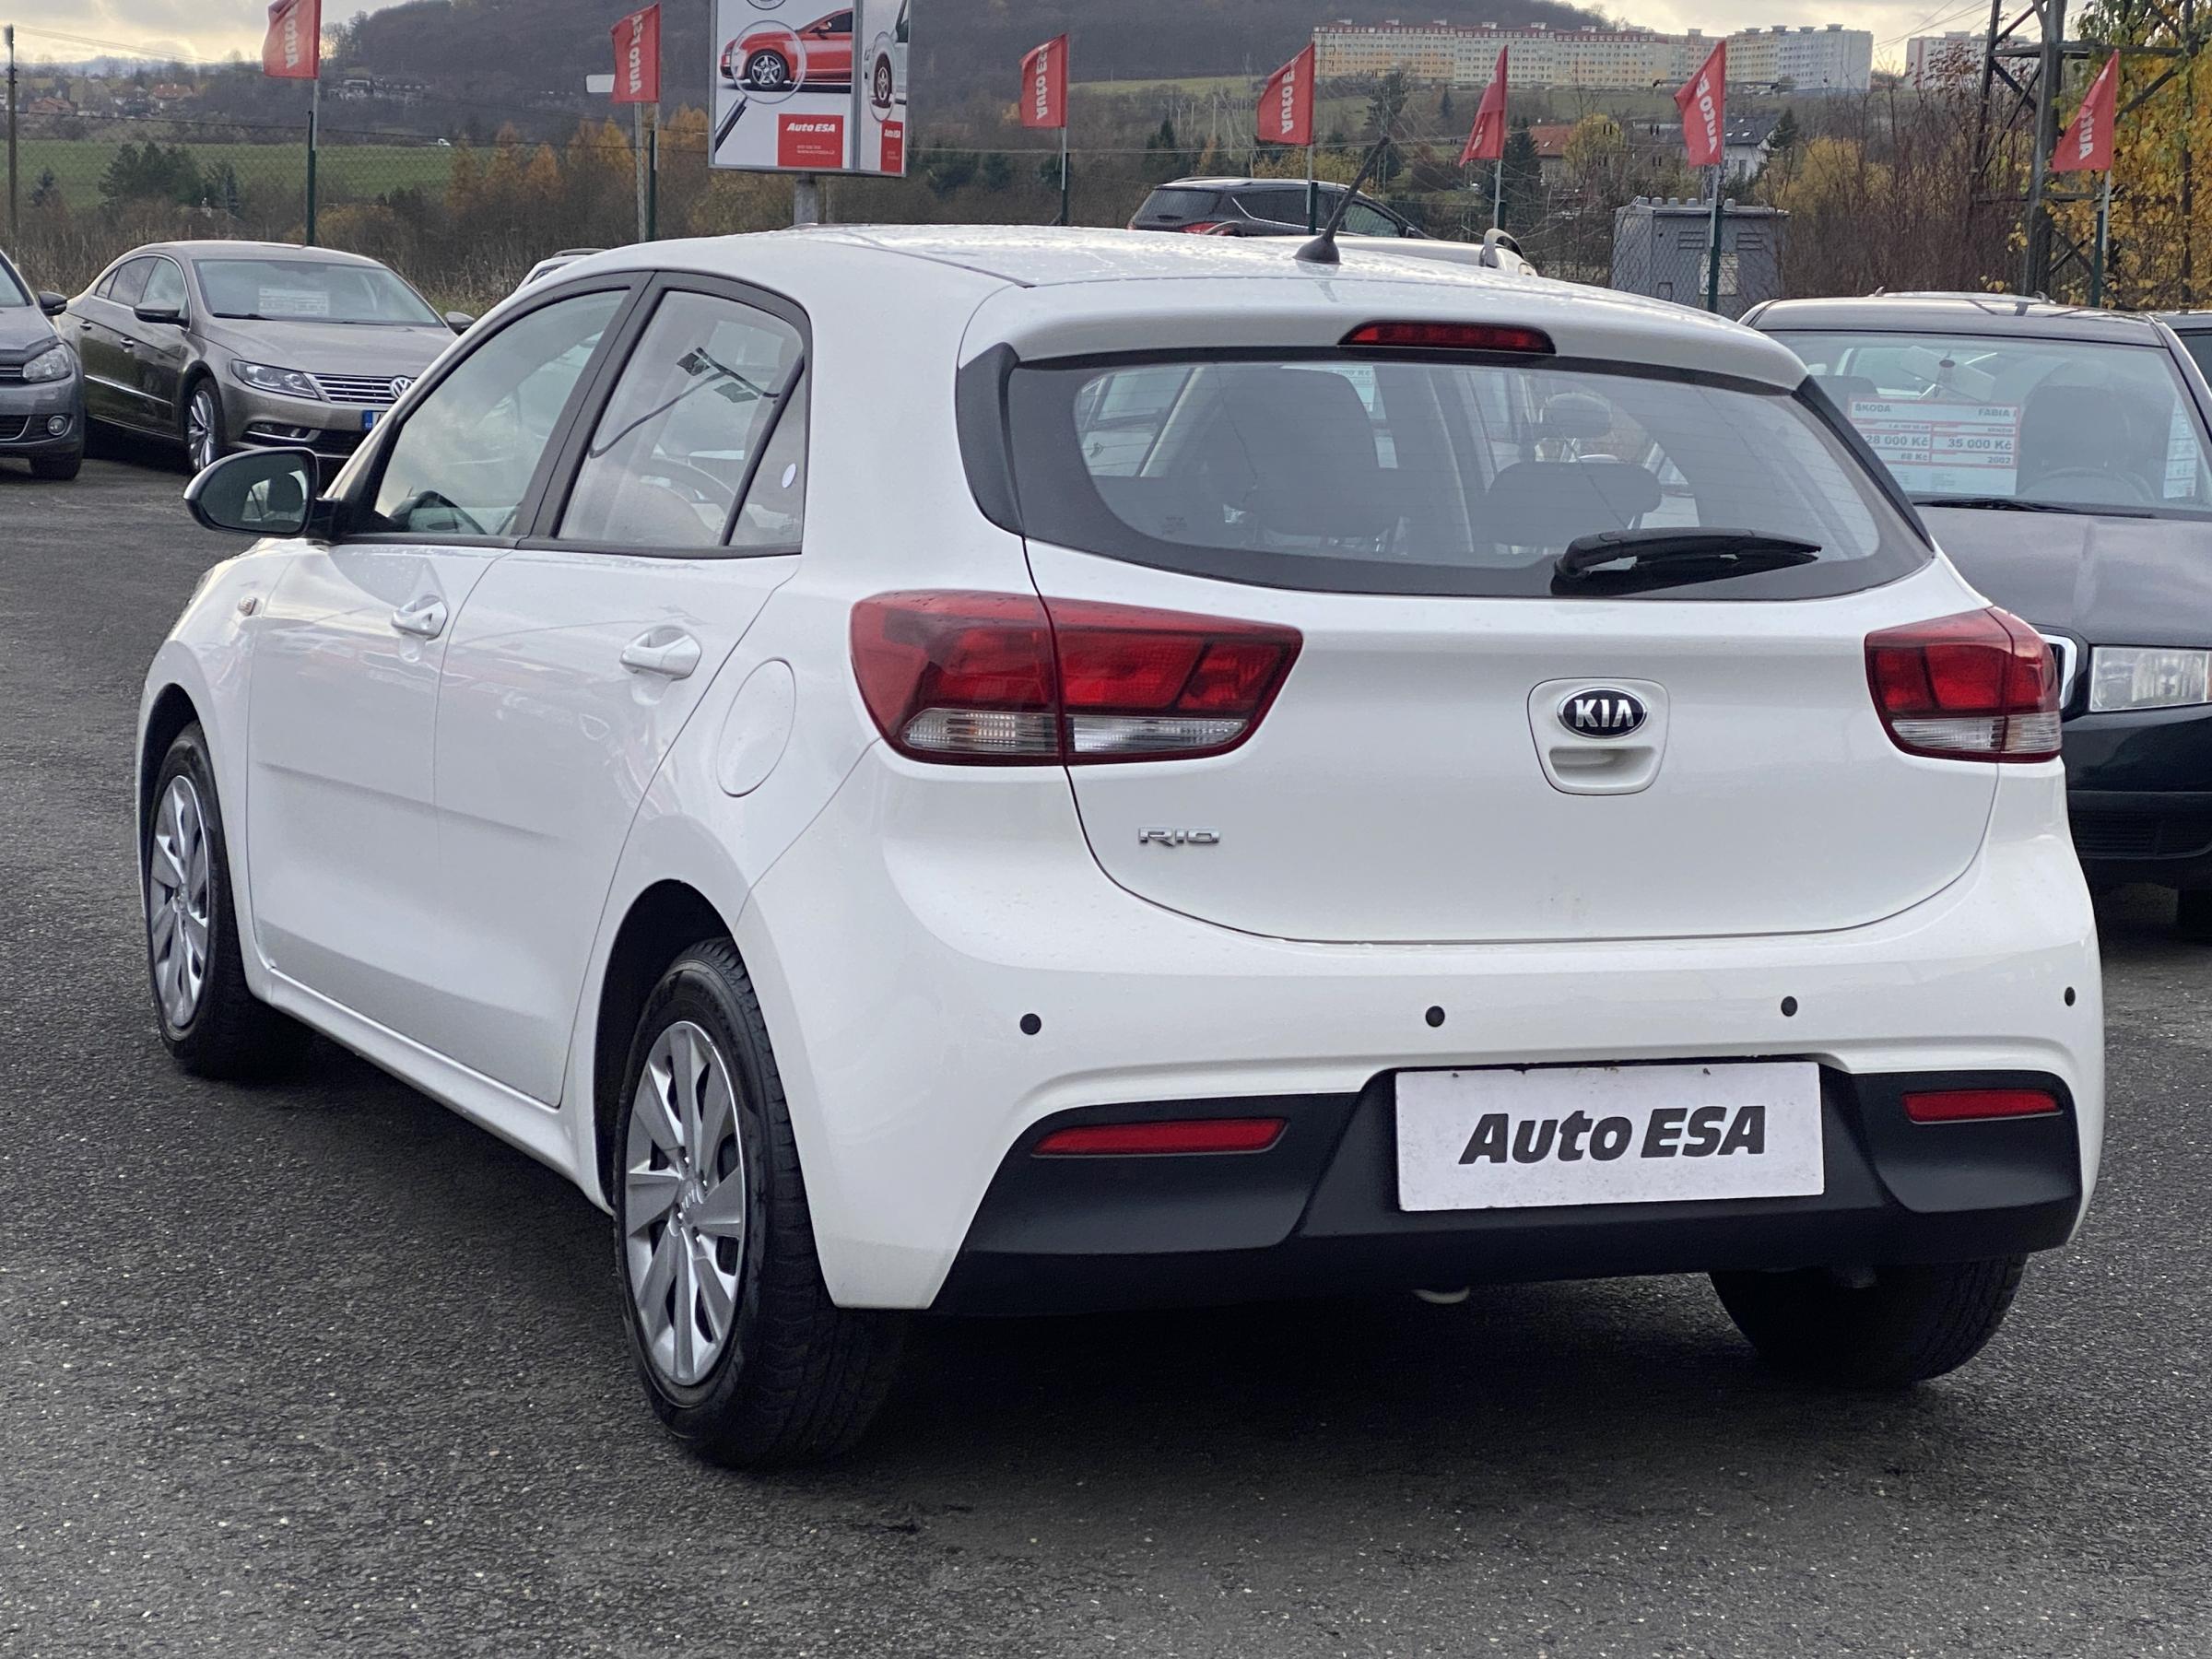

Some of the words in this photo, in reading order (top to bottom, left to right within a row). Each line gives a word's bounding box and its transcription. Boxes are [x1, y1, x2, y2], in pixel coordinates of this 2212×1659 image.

[787, 123, 814, 132] Auto
[815, 124, 836, 133] ESA
[1978, 407, 2010, 417] FABIA
[1885, 435, 1908, 445] 000
[1911, 436, 1929, 446] Kč
[1947, 438, 1963, 448] 35
[1967, 439, 1991, 449] 000
[1994, 440, 2012, 450] Kč
[1574, 699, 1635, 727] KIA
[1138, 827, 1219, 847] RIO
[1458, 1110, 1633, 1165] Auto
[1640, 1105, 1766, 1159] ESA
